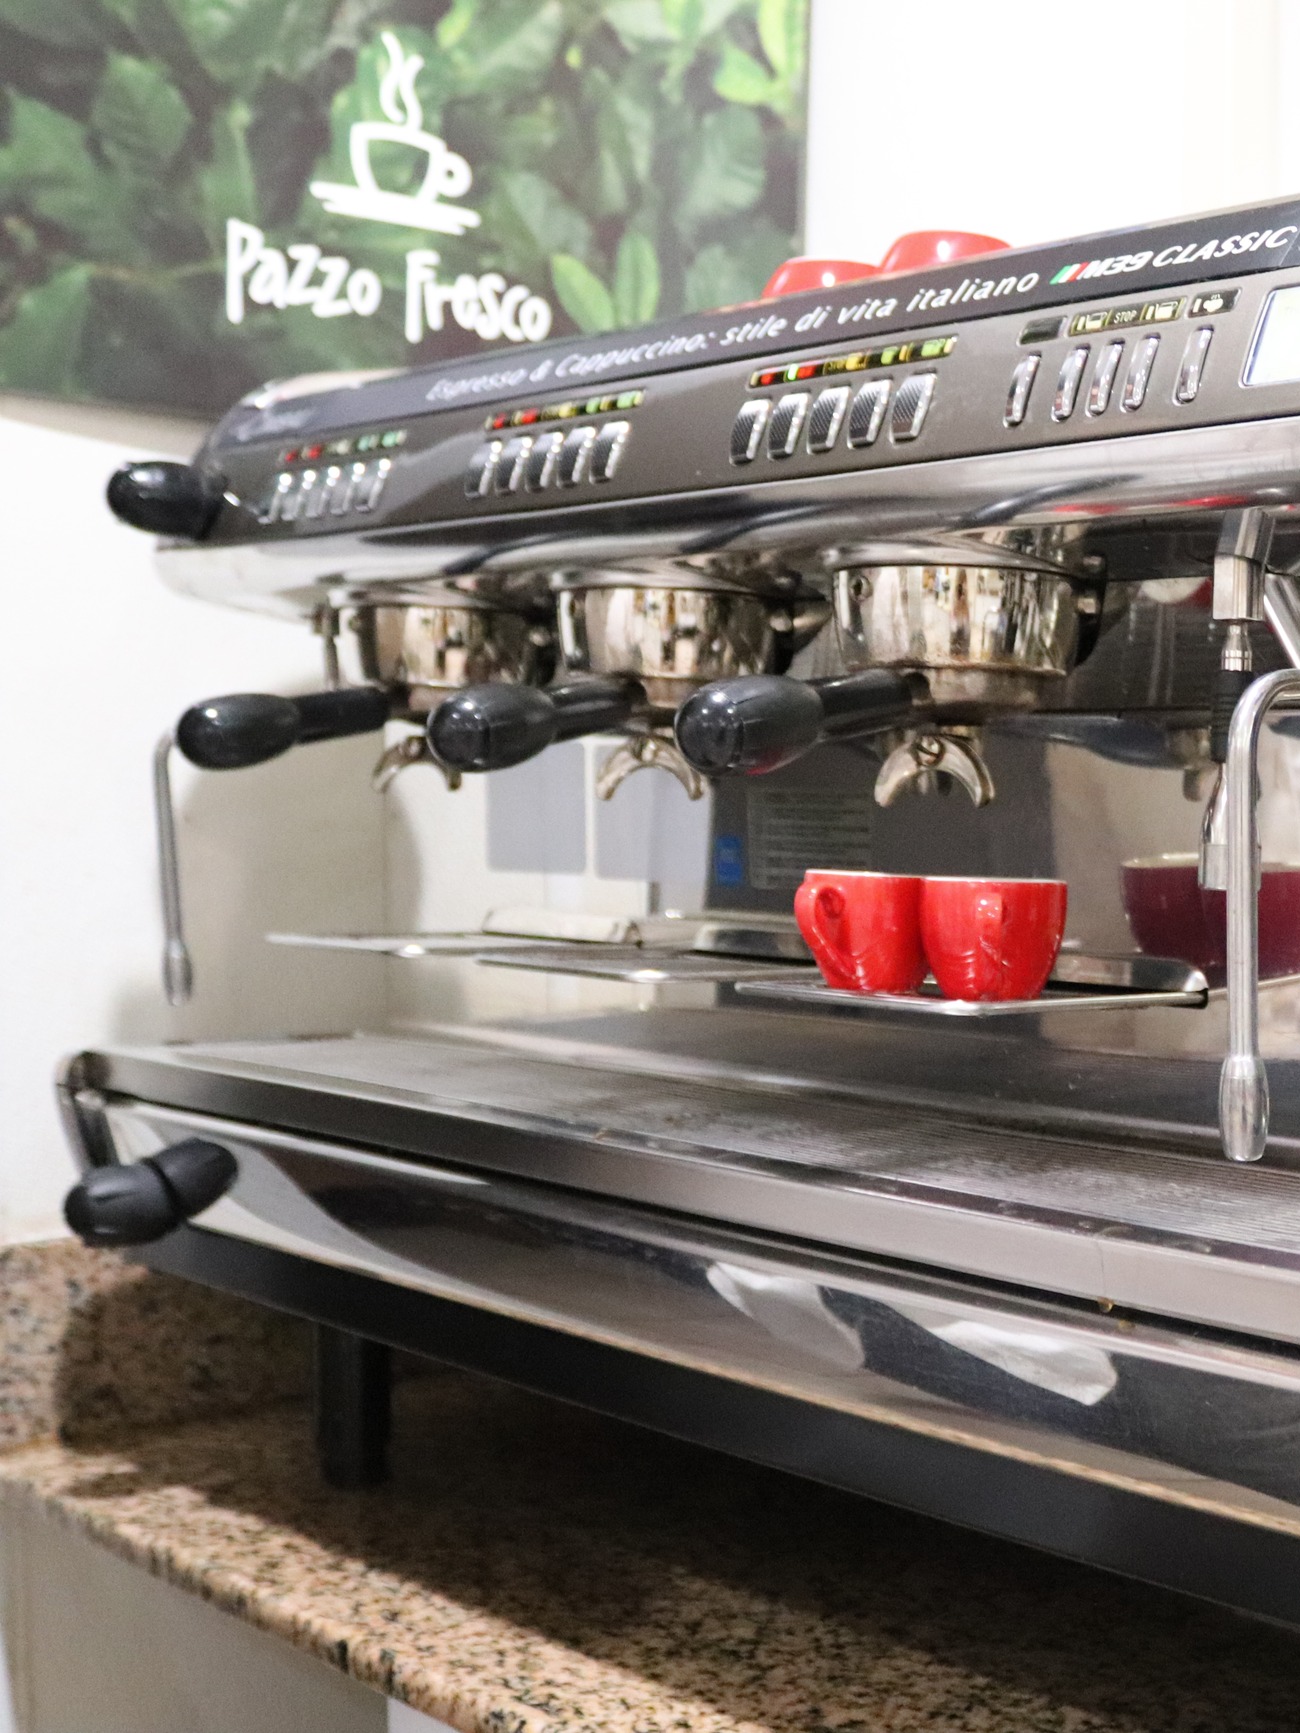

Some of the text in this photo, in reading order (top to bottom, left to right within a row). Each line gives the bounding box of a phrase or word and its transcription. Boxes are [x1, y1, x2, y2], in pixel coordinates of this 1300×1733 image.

[226, 217, 551, 342] Pazzo Fresco
[1079, 225, 1298, 281] M39 CLASSIC
[719, 314, 787, 346] stile
[794, 305, 832, 332] di
[837, 297, 898, 324] vita
[906, 272, 1040, 312] italiano
[1113, 309, 1138, 324] STOP
